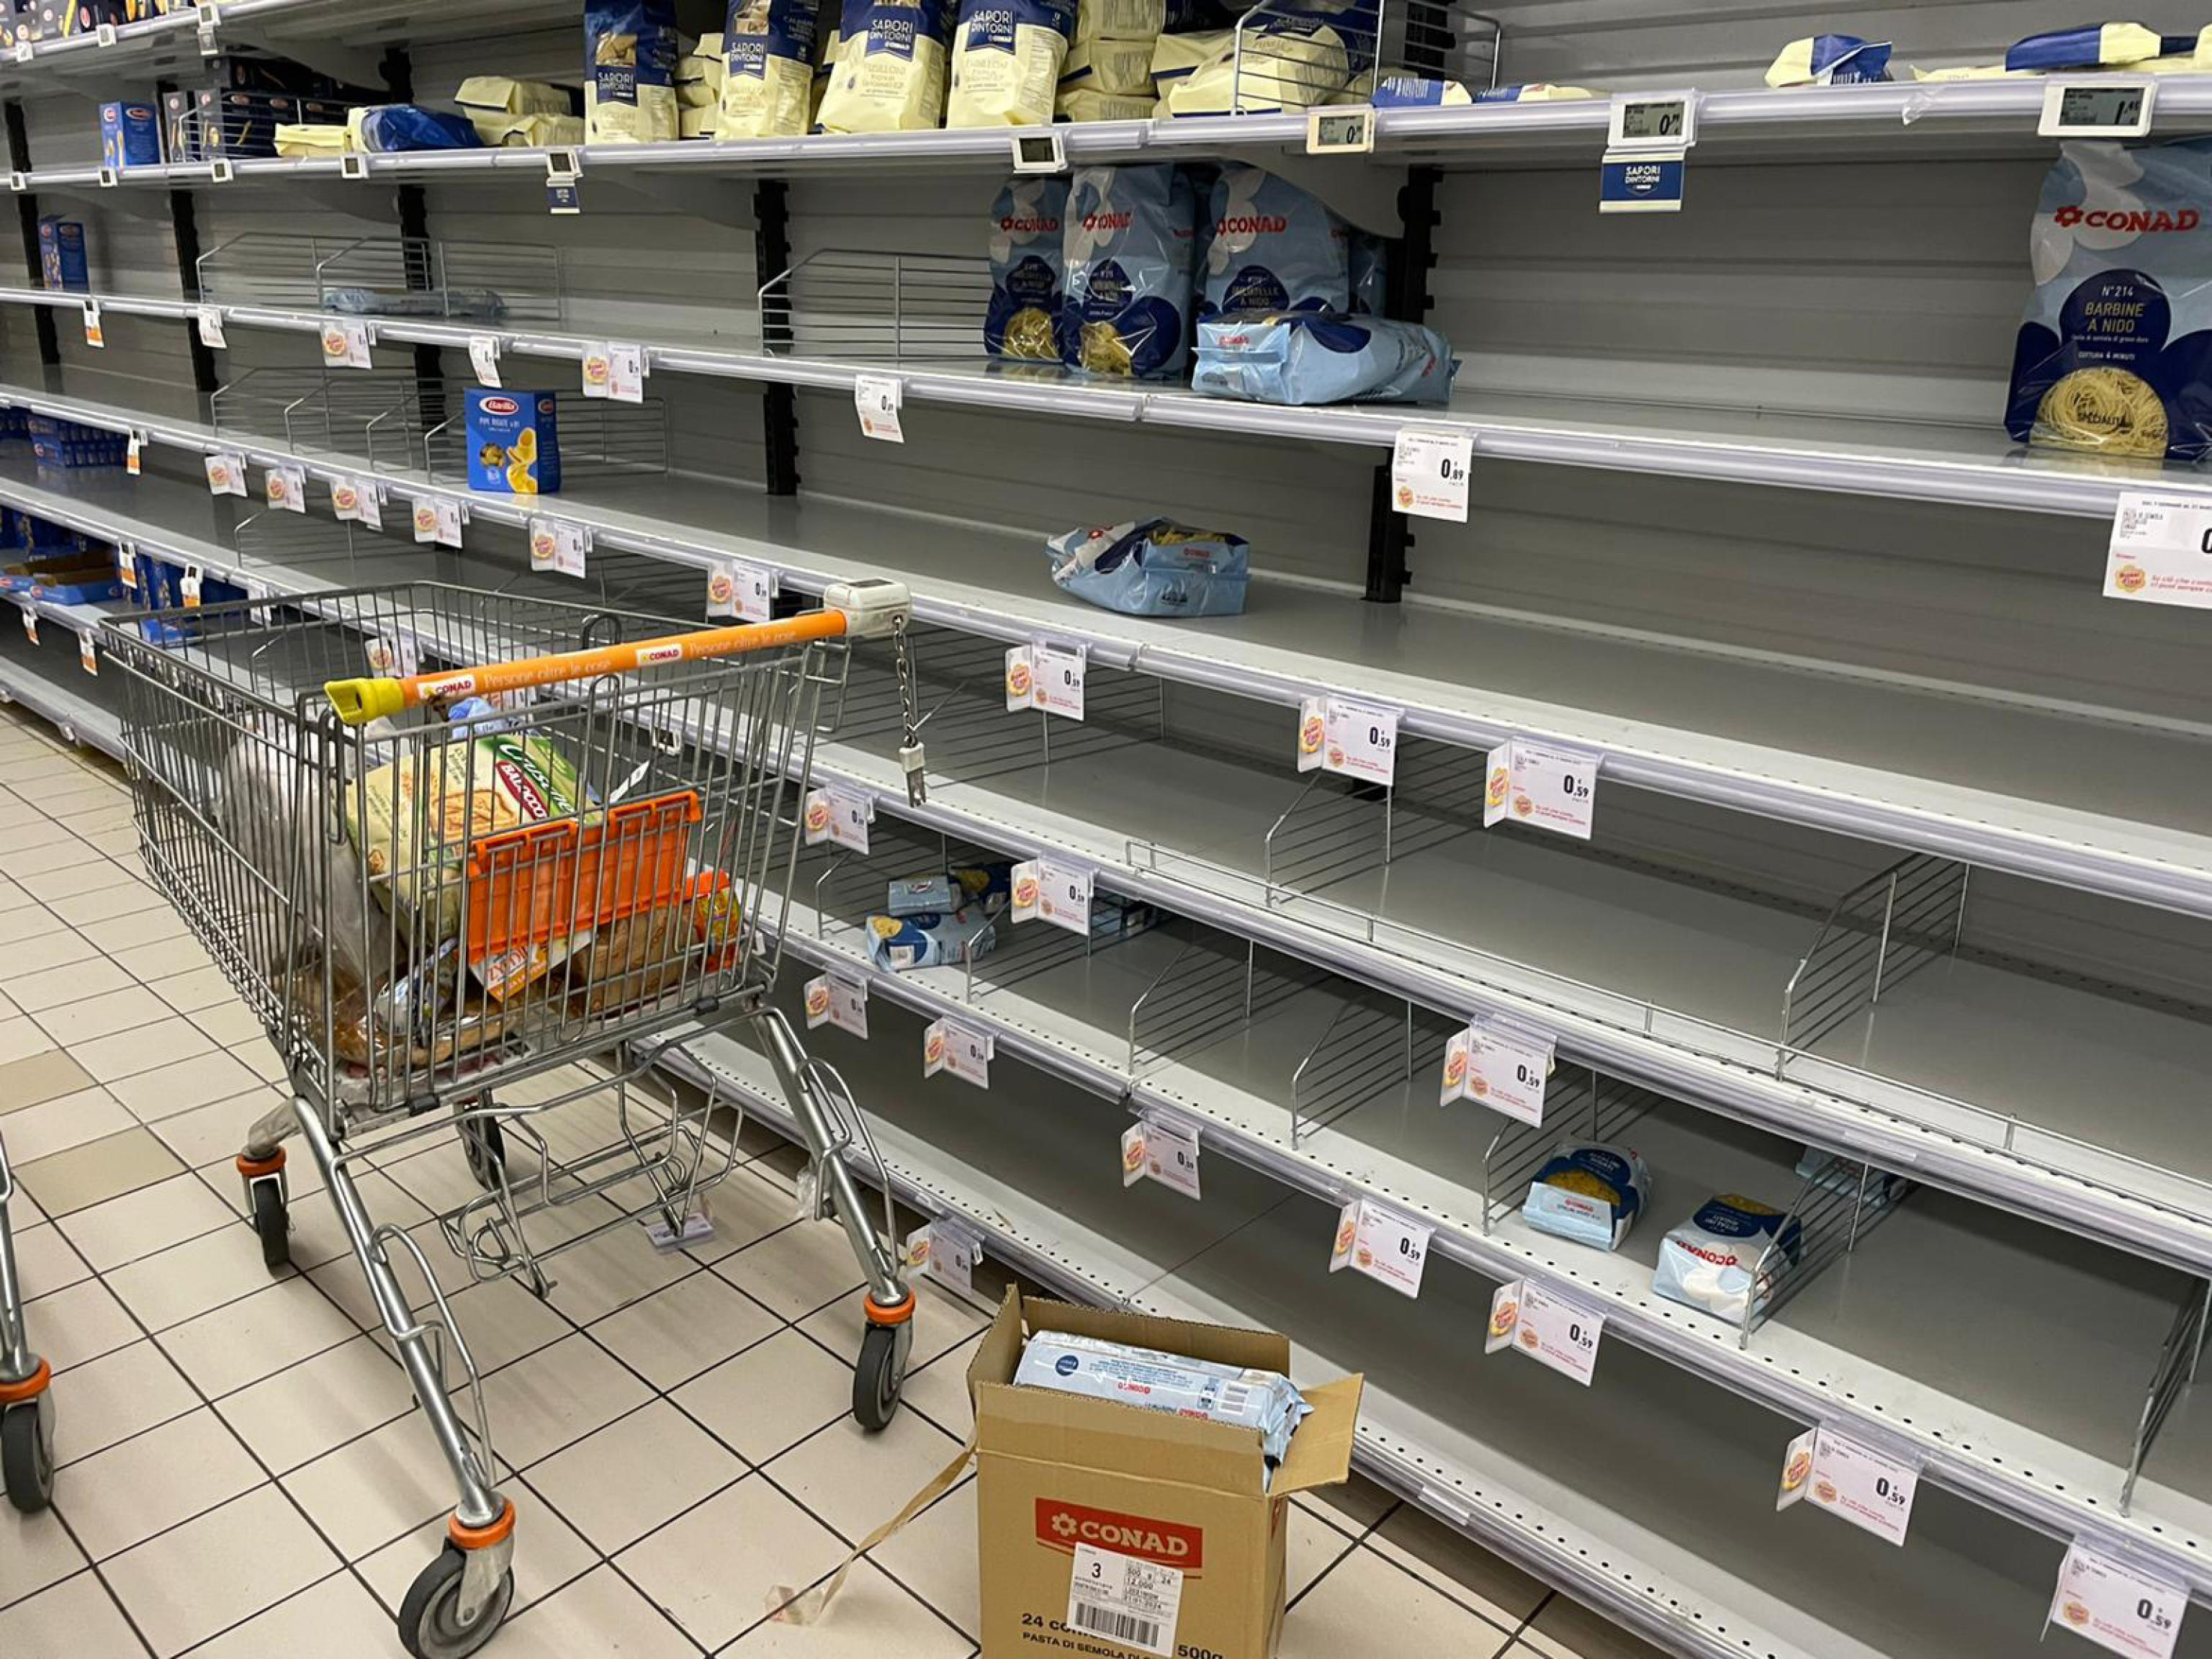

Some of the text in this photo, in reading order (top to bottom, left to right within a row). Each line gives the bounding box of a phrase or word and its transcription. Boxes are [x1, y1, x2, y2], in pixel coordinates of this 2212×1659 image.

[972, 11, 1012, 24] SAPORI
[872, 19, 913, 33] SAPORI
[731, 42, 765, 54] SAPORI
[598, 72, 634, 84] SAPORI
[1627, 165, 1660, 175] SAPORI
[1227, 215, 1287, 234] CONAD
[2085, 209, 2200, 233] CONAD
[2085, 302, 2146, 317] BARBINE
[2087, 319, 2135, 333] A NIDO
[649, 648, 678, 661] CONAD
[487, 671, 532, 687] Persone
[1080, 1521, 1188, 1556] CONAD
[1092, 1563, 1102, 1578] 3
[1022, 1613, 1043, 1628] 24
[1022, 1632, 1060, 1647] PASTA
[1063, 1640, 1075, 1650] DI
[1077, 1642, 1125, 1659] SEMOLA
